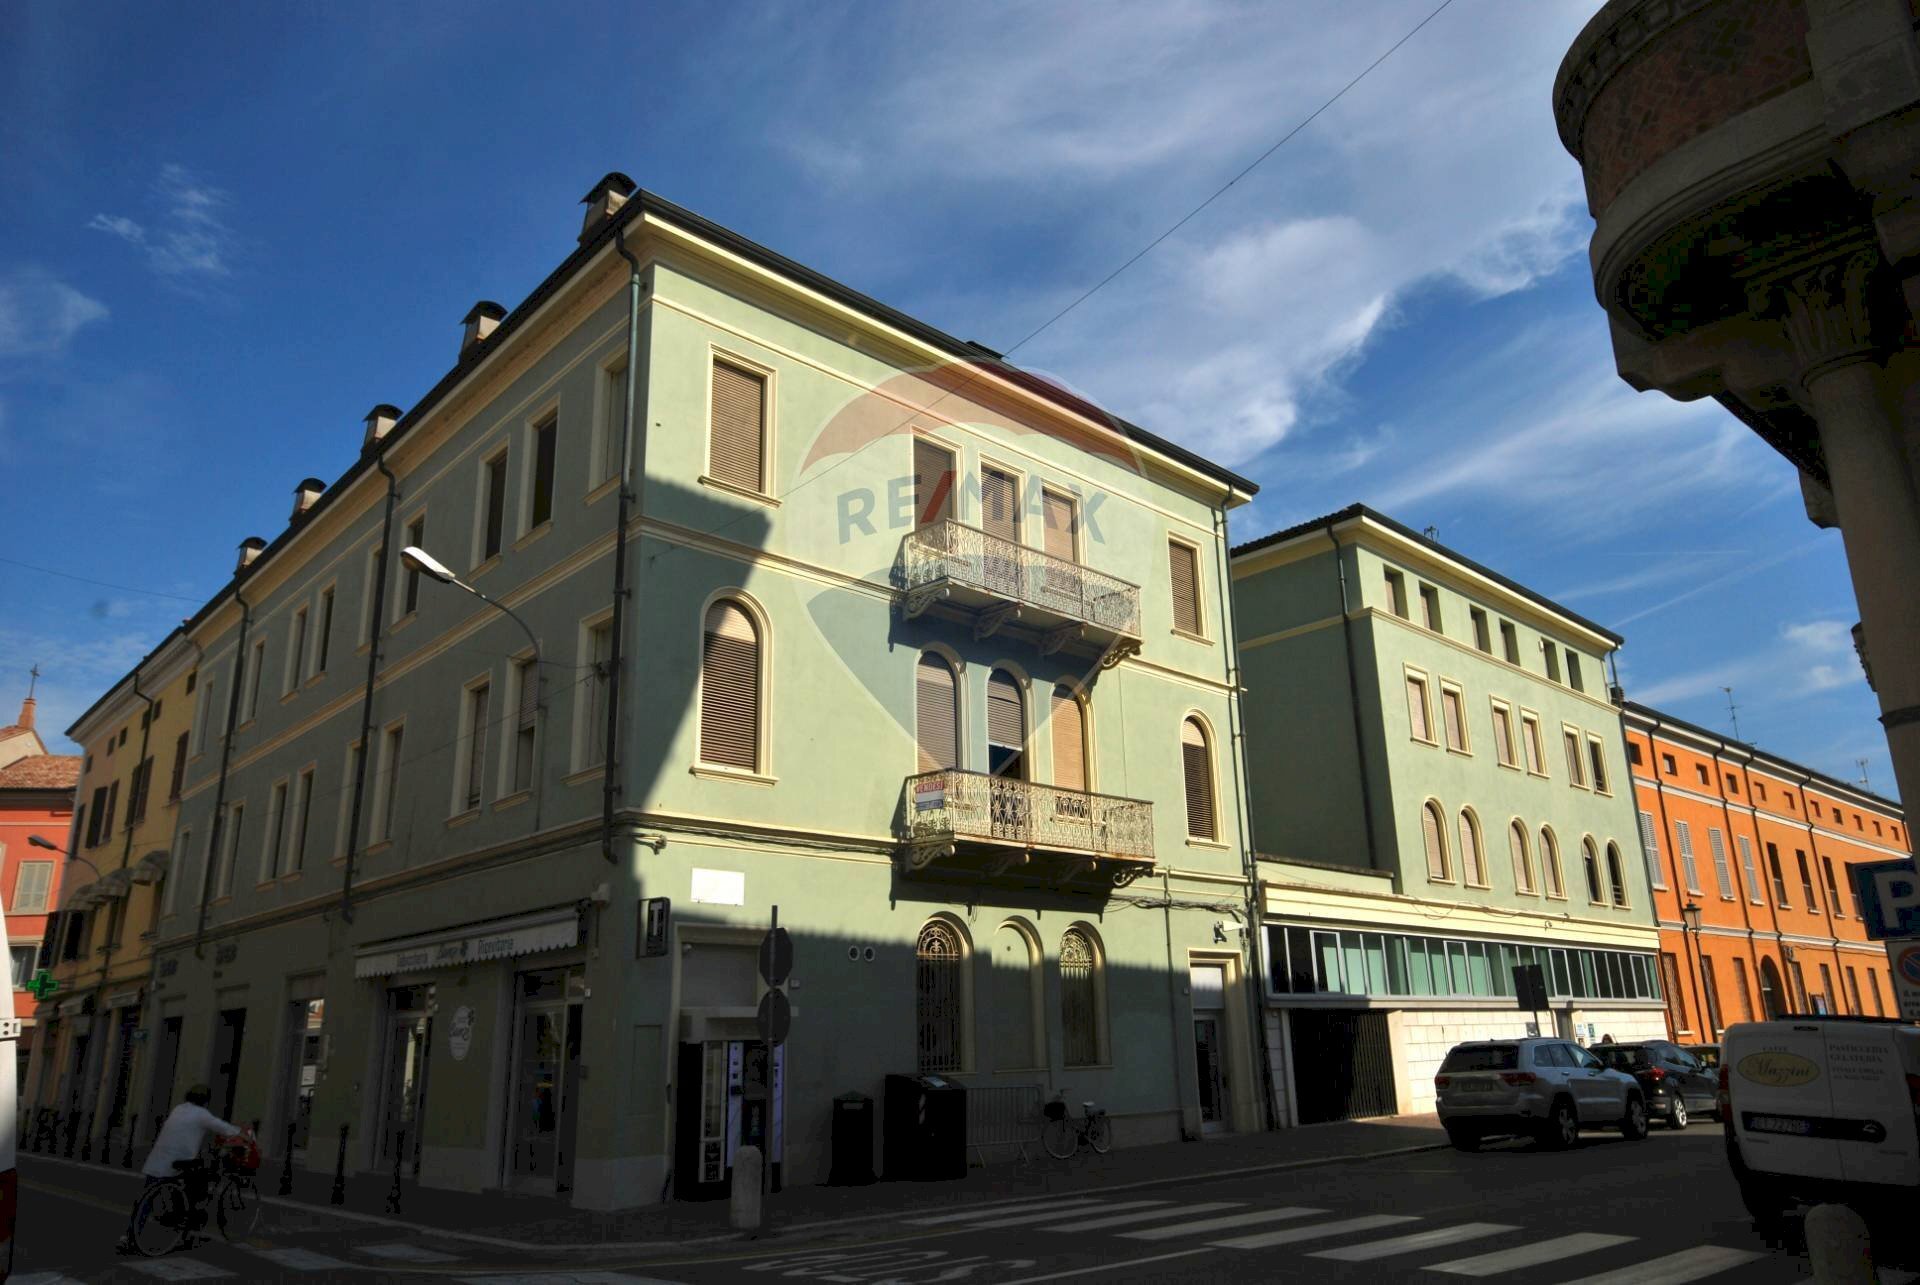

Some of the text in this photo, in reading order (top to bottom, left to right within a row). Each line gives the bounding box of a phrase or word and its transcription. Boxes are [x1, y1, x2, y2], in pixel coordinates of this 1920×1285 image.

[1874, 869, 1920, 930] P
[1829, 1043, 1889, 1055] PASTICCERIA
[1829, 1053, 1883, 1064] GELATERIA
